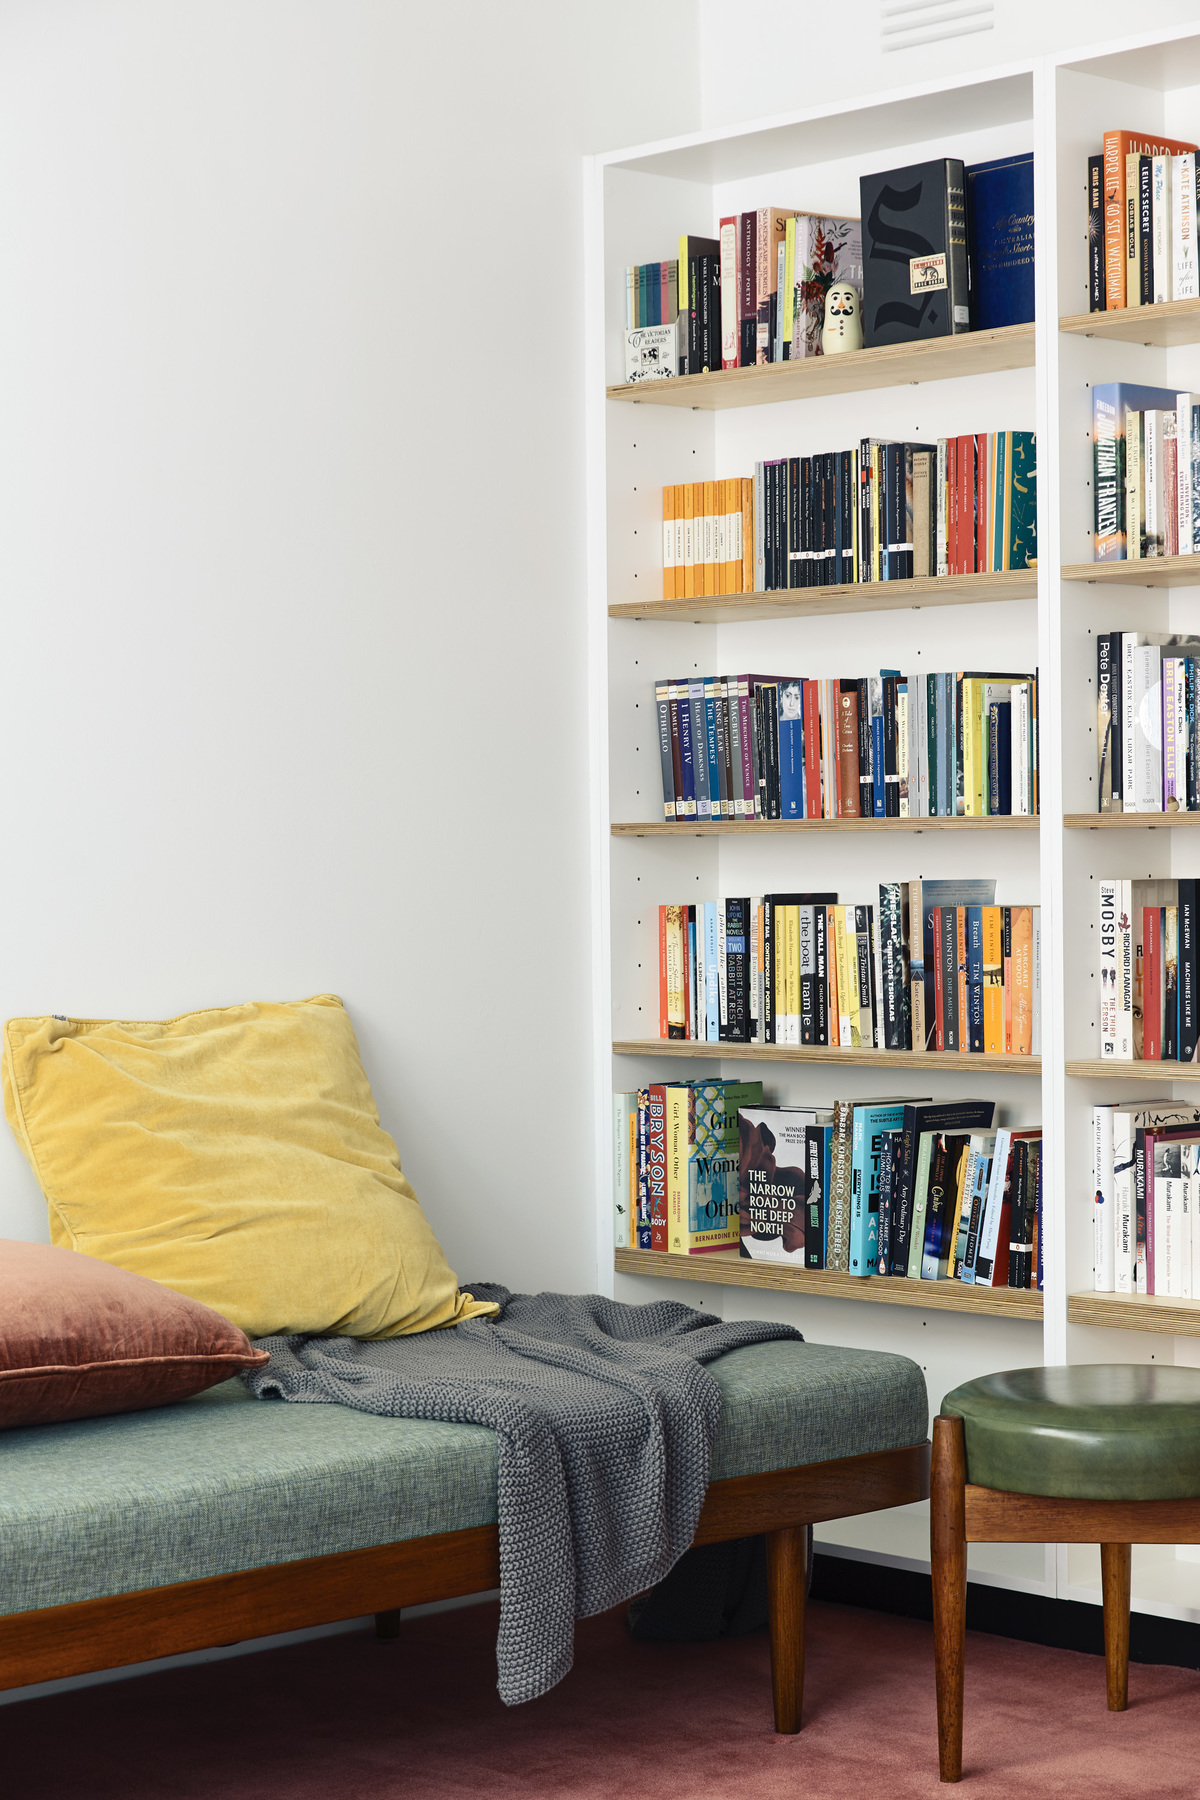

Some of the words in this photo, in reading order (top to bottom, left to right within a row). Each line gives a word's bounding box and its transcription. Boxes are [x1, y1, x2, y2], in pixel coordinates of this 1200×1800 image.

[1105, 137, 1118, 174] HARPER
[1155, 164, 1163, 178] My
[1181, 168, 1189, 190] KATE
[1106, 177, 1119, 191] LEE
[1141, 166, 1149, 198] LEILA'S
[1155, 180, 1163, 201] Place
[1107, 204, 1119, 216] GO
[1182, 194, 1190, 240] ATKINSON
[1107, 220, 1120, 234] SET
[1108, 246, 1121, 300] WATCHMAN
[1097, 400, 1115, 415] FREEDOM
[1097, 413, 1115, 477] JONATHAN
[1098, 482, 1116, 539] FRANZEN
[1100, 642, 1109, 669] Pete
[1100, 674, 1110, 716] Dexter
[1189, 693, 1194, 702] K.
[1166, 696, 1174, 742] EASTON
[697, 730, 702, 740] OF
[684, 753, 691, 764] IV
[745, 753, 749, 761] OF
[1167, 746, 1175, 778] ELLIS
[801, 917, 810, 936] the
[1101, 894, 1115, 958] MOSBY
[728, 943, 742, 953] TWO
[801, 940, 811, 967] boat
[707, 964, 718, 1004] Updike
[737, 988, 743, 996] IS
[729, 989, 735, 1000] AT
[803, 981, 811, 1010] nam
[803, 1014, 812, 1025] le
[1185, 1017, 1191, 1027] ME
[650, 1103, 665, 1196] BRYSON
[748, 1170, 767, 1182] THE
[886, 1170, 891, 1182] TO
[1136, 1149, 1144, 1199] MURAKAMI
[749, 1183, 795, 1197] NARROW
[885, 1183, 890, 1194] BE
[750, 1197, 778, 1209] ROAD
[781, 1199, 796, 1210] TO
[749, 1209, 767, 1220] THE
[769, 1210, 794, 1223] DEEP
[898, 1200, 908, 1229] Ordinary
[750, 1223, 784, 1235] NORTH
[834, 1200, 842, 1253] UNSHELTERED
[898, 1230, 906, 1243] Day
[966, 1236, 975, 1265] HOMER
